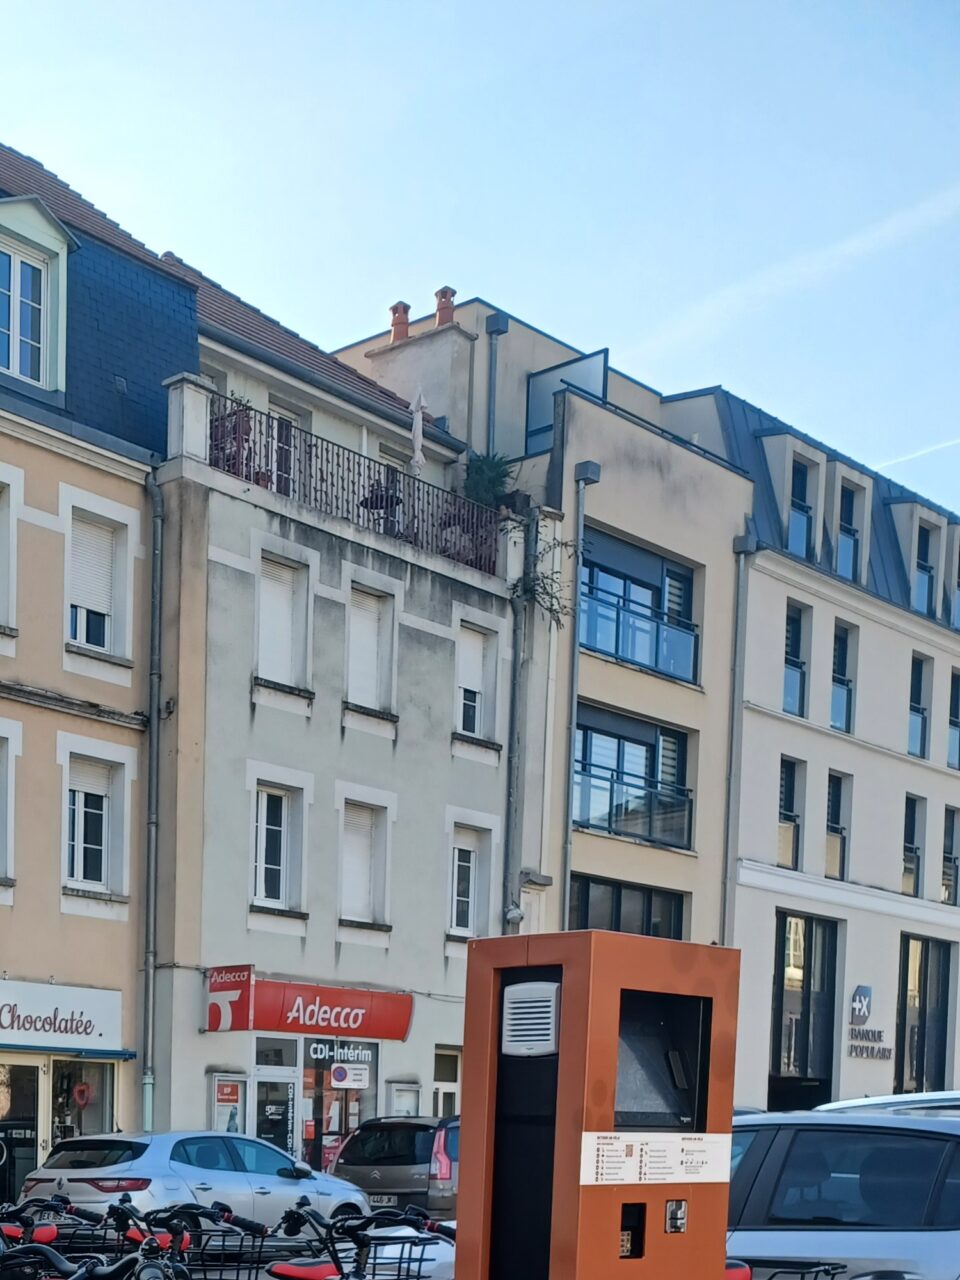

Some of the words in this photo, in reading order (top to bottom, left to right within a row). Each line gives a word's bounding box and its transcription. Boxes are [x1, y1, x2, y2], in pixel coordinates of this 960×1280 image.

[211, 971, 249, 983] Adecco
[287, 996, 366, 1029] Adecco
[848, 1028, 884, 1043] BANQUE
[309, 1043, 372, 1062] CDI-Intérim
[848, 1044, 893, 1060] POPULAIRE
